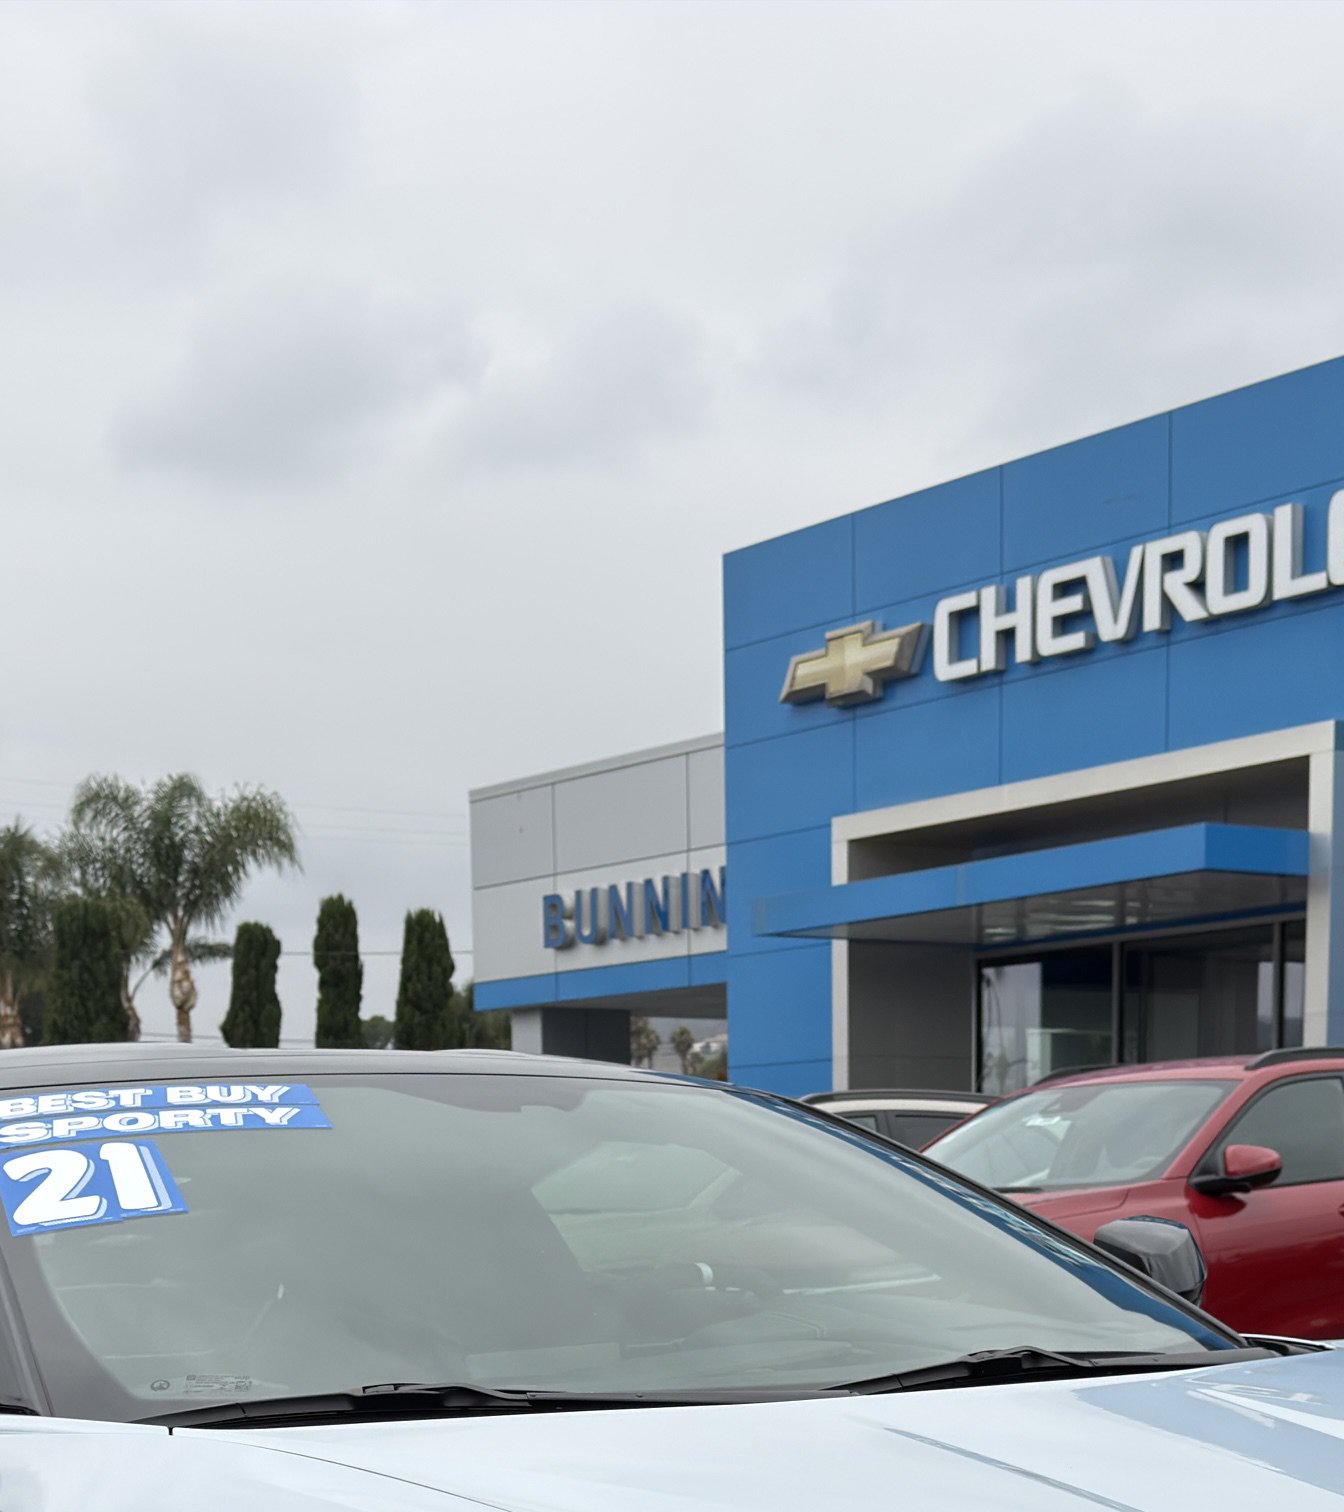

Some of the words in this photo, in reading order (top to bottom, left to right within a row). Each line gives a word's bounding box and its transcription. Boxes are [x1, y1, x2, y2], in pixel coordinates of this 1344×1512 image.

[542, 865, 726, 950] BUNNIN
[166, 1084, 291, 1105] BUY
[2, 1142, 173, 1227] 21
